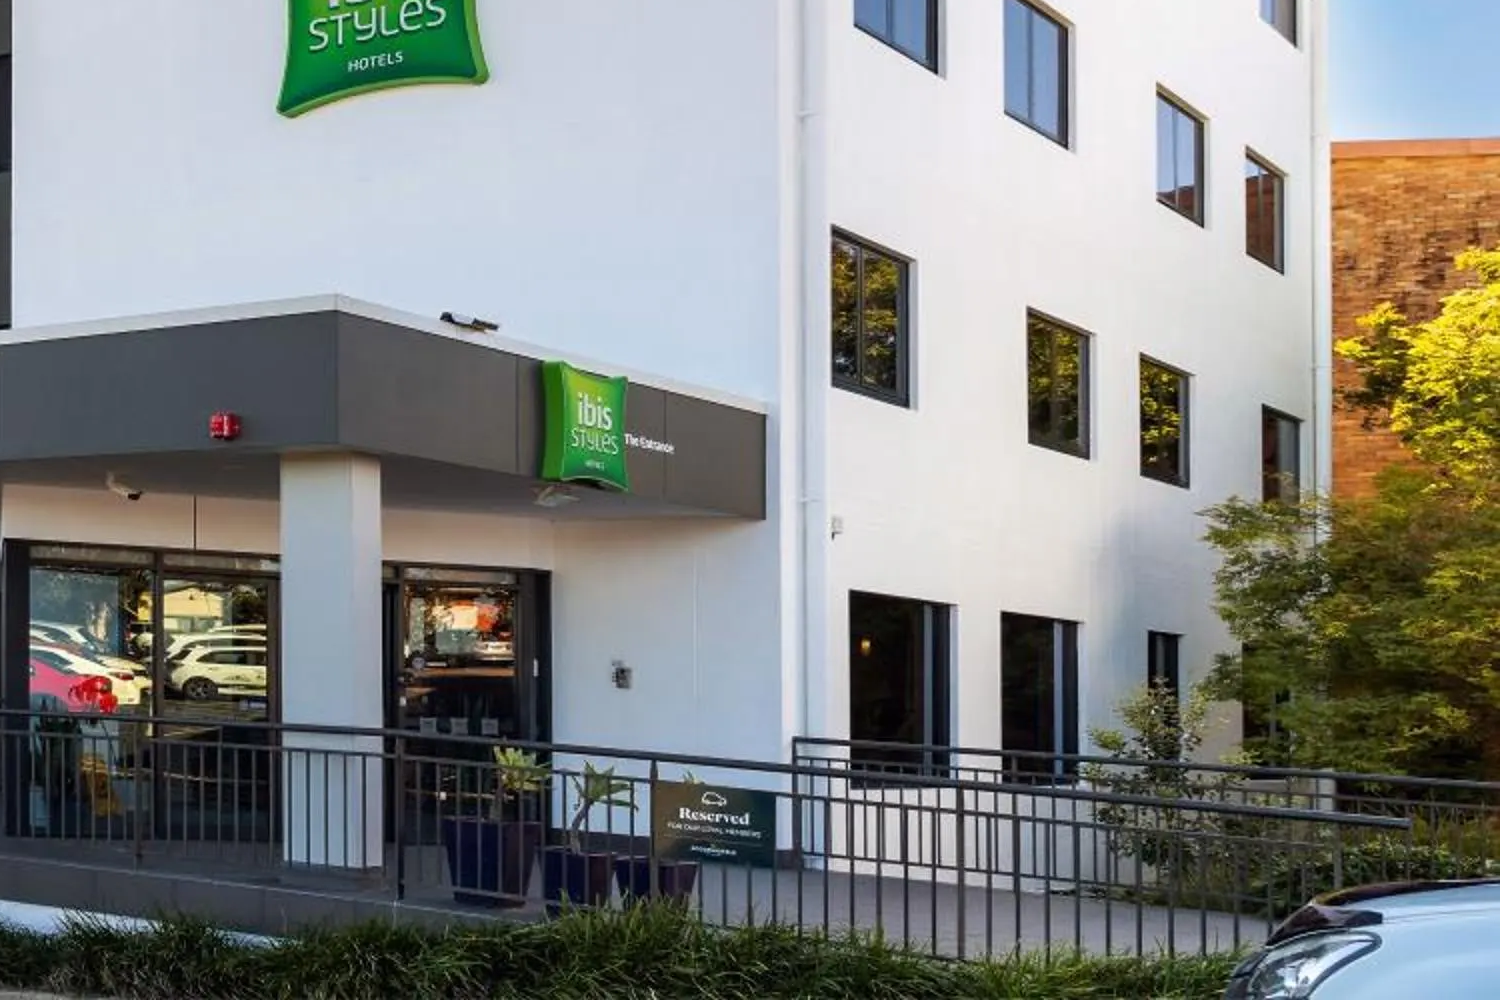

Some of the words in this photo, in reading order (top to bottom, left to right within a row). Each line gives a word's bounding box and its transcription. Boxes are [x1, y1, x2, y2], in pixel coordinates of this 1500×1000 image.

[347, 51, 404, 72] HOTELS
[577, 392, 613, 430] ibis
[624, 433, 639, 447] The
[640, 436, 675, 454] Entrance
[679, 807, 749, 825] Reserved
